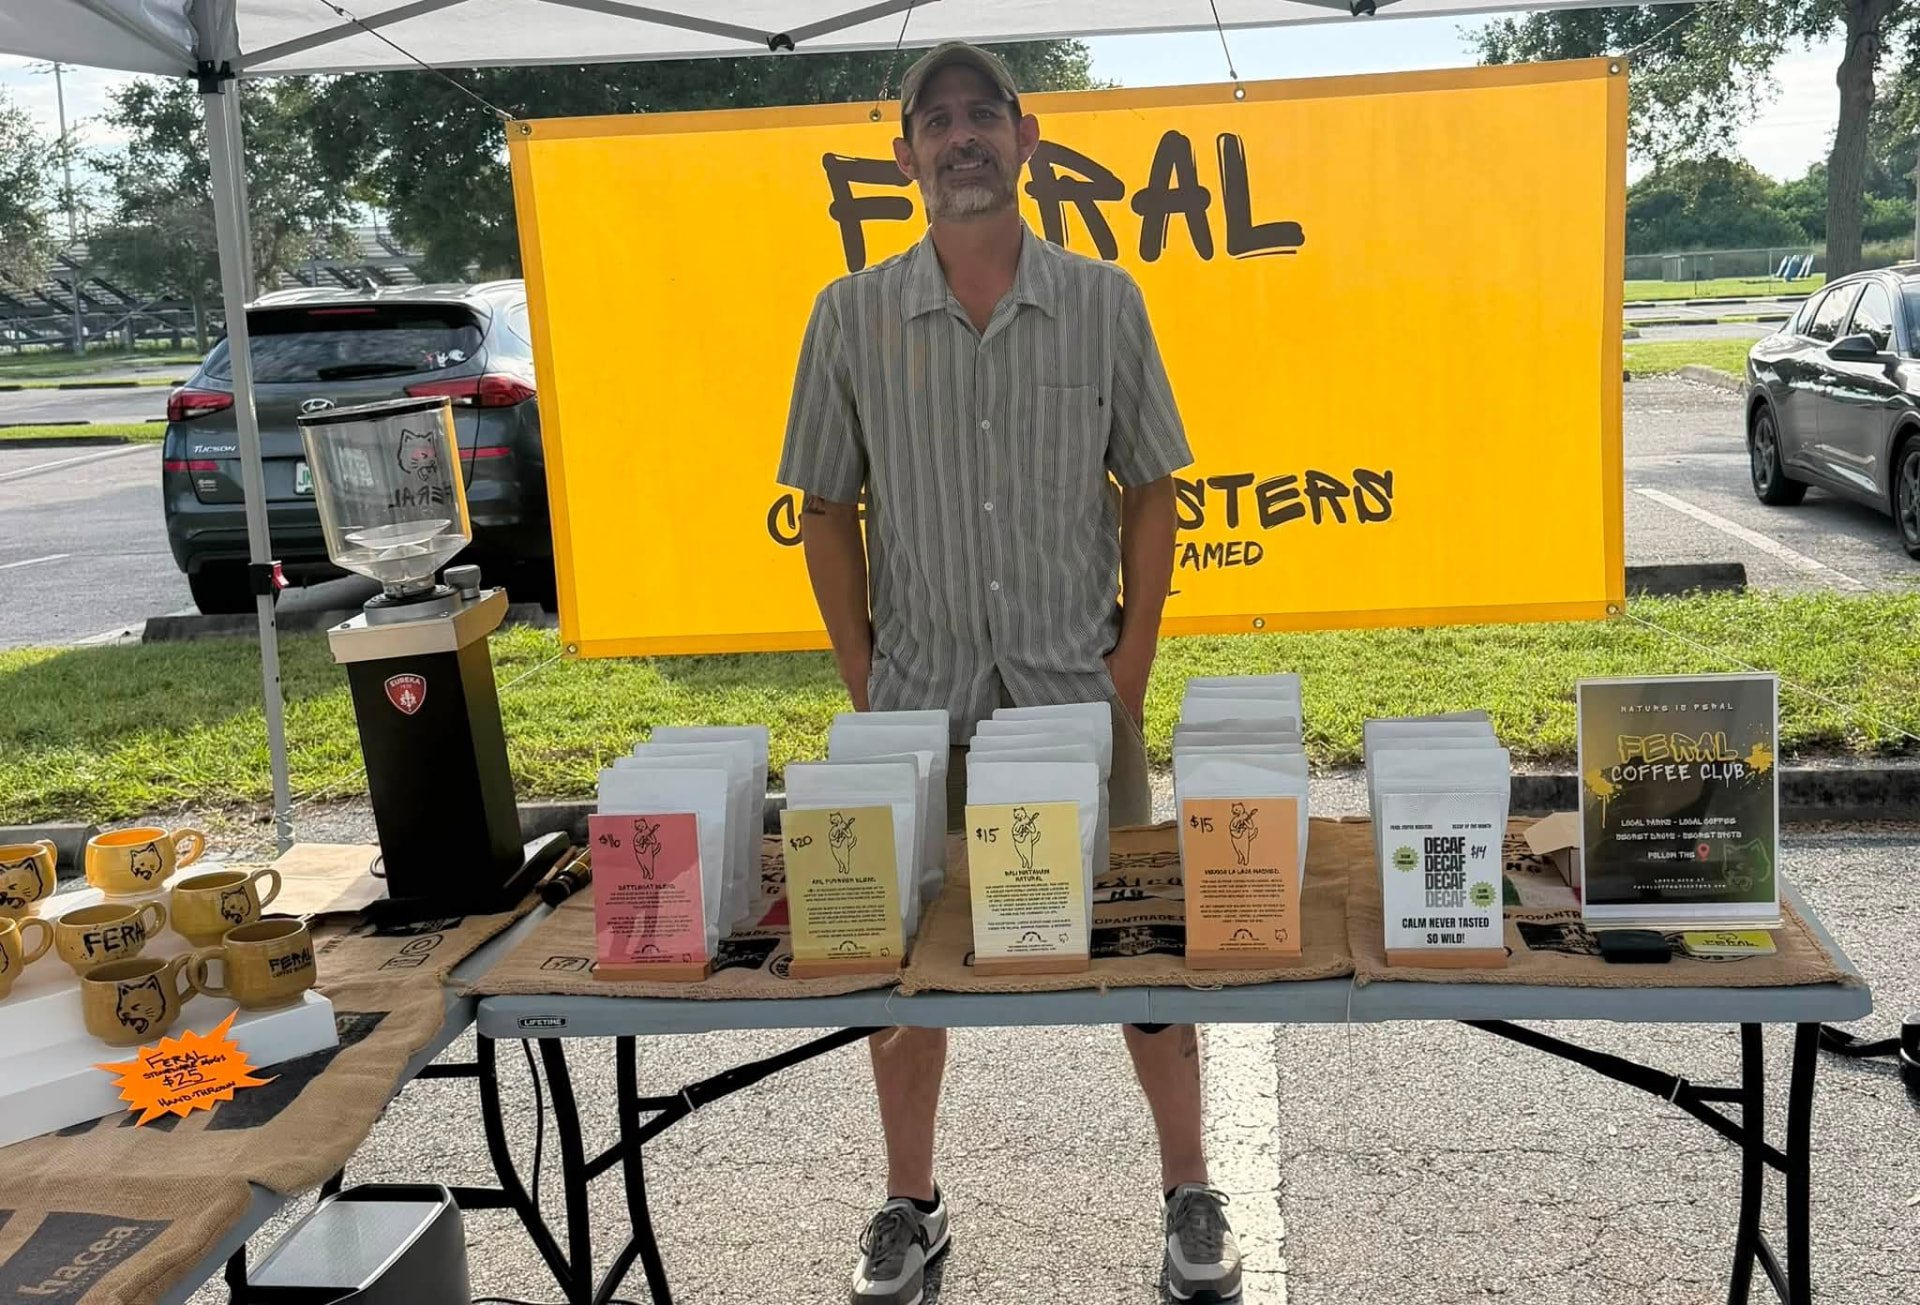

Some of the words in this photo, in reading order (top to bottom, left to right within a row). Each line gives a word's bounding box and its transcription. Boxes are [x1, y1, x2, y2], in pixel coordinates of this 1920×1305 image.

[822, 129, 1306, 273] FRAL
[194, 444, 237, 453] TUCSON
[1176, 468, 1394, 530] STERS
[1175, 541, 1264, 571] AMED
[1617, 731, 1739, 764] FERAL
[1611, 763, 1692, 783] COFFEE
[1700, 763, 1745, 789] CLUB
[1190, 815, 1214, 834] $15
[599, 834, 621, 849] $16
[790, 835, 813, 851] $20
[976, 828, 1000, 843] $15
[1424, 836, 1466, 855] DECAF
[1471, 845, 1487, 859] $14
[1424, 855, 1466, 873] DECAF
[1425, 872, 1466, 891] DECAF
[1425, 890, 1466, 908] DECAF
[1402, 918, 1427, 928] CALM
[1429, 918, 1456, 928] NEVER
[1458, 917, 1490, 928] TASTED
[1426, 933, 1438, 944] SO
[1441, 933, 1465, 944] WILD!
[269, 947, 313, 972] FERAL
[145, 1050, 209, 1069] FERAL
[162, 1068, 204, 1087] $25
